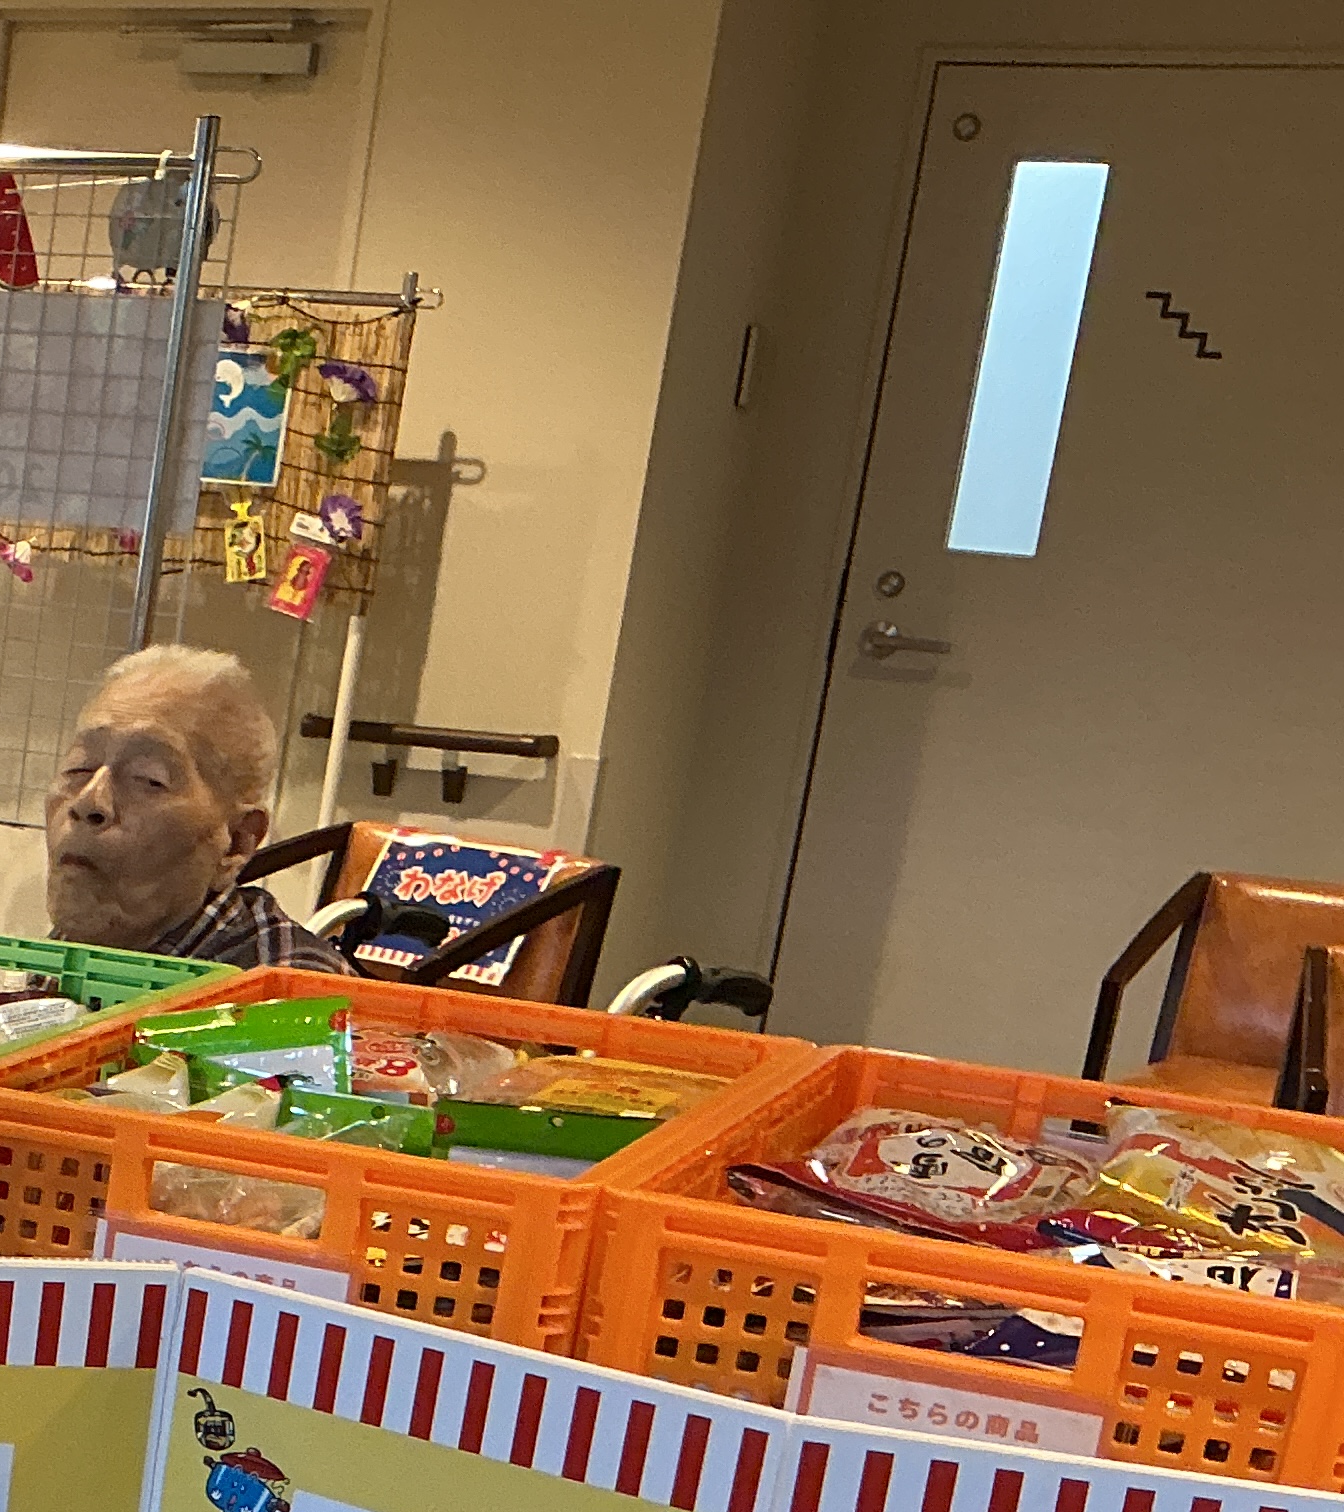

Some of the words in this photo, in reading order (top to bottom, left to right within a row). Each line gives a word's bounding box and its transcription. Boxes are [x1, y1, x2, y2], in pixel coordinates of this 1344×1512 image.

[865, 1390, 1042, 1445] こちらの商品
